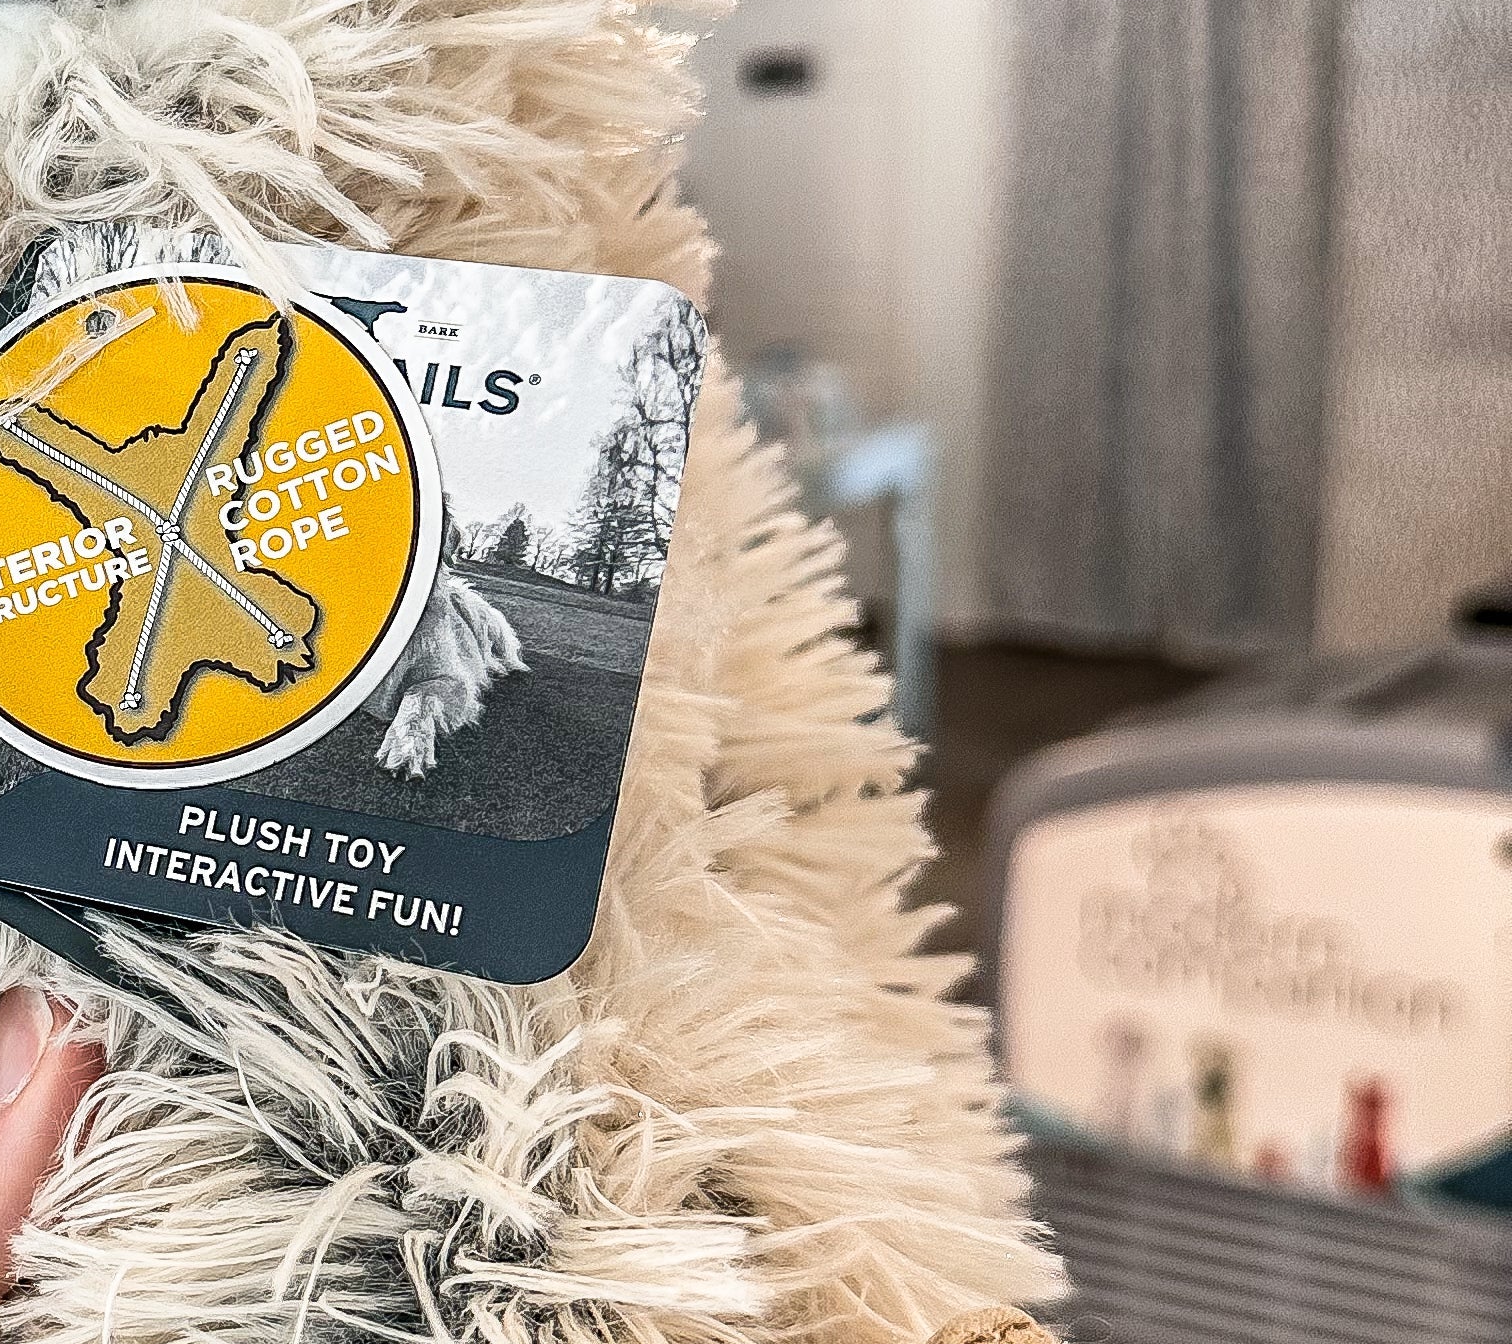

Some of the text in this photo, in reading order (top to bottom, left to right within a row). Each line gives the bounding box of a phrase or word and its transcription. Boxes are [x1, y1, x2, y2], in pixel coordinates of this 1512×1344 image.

[418, 324, 459, 338] BARK
[205, 410, 385, 497] RUGGED
[218, 444, 400, 531] COTTON
[228, 505, 350, 572] ROPE
[178, 805, 406, 875] PLUSH TOY
[103, 838, 464, 937] INTERACTIVE FUN!
